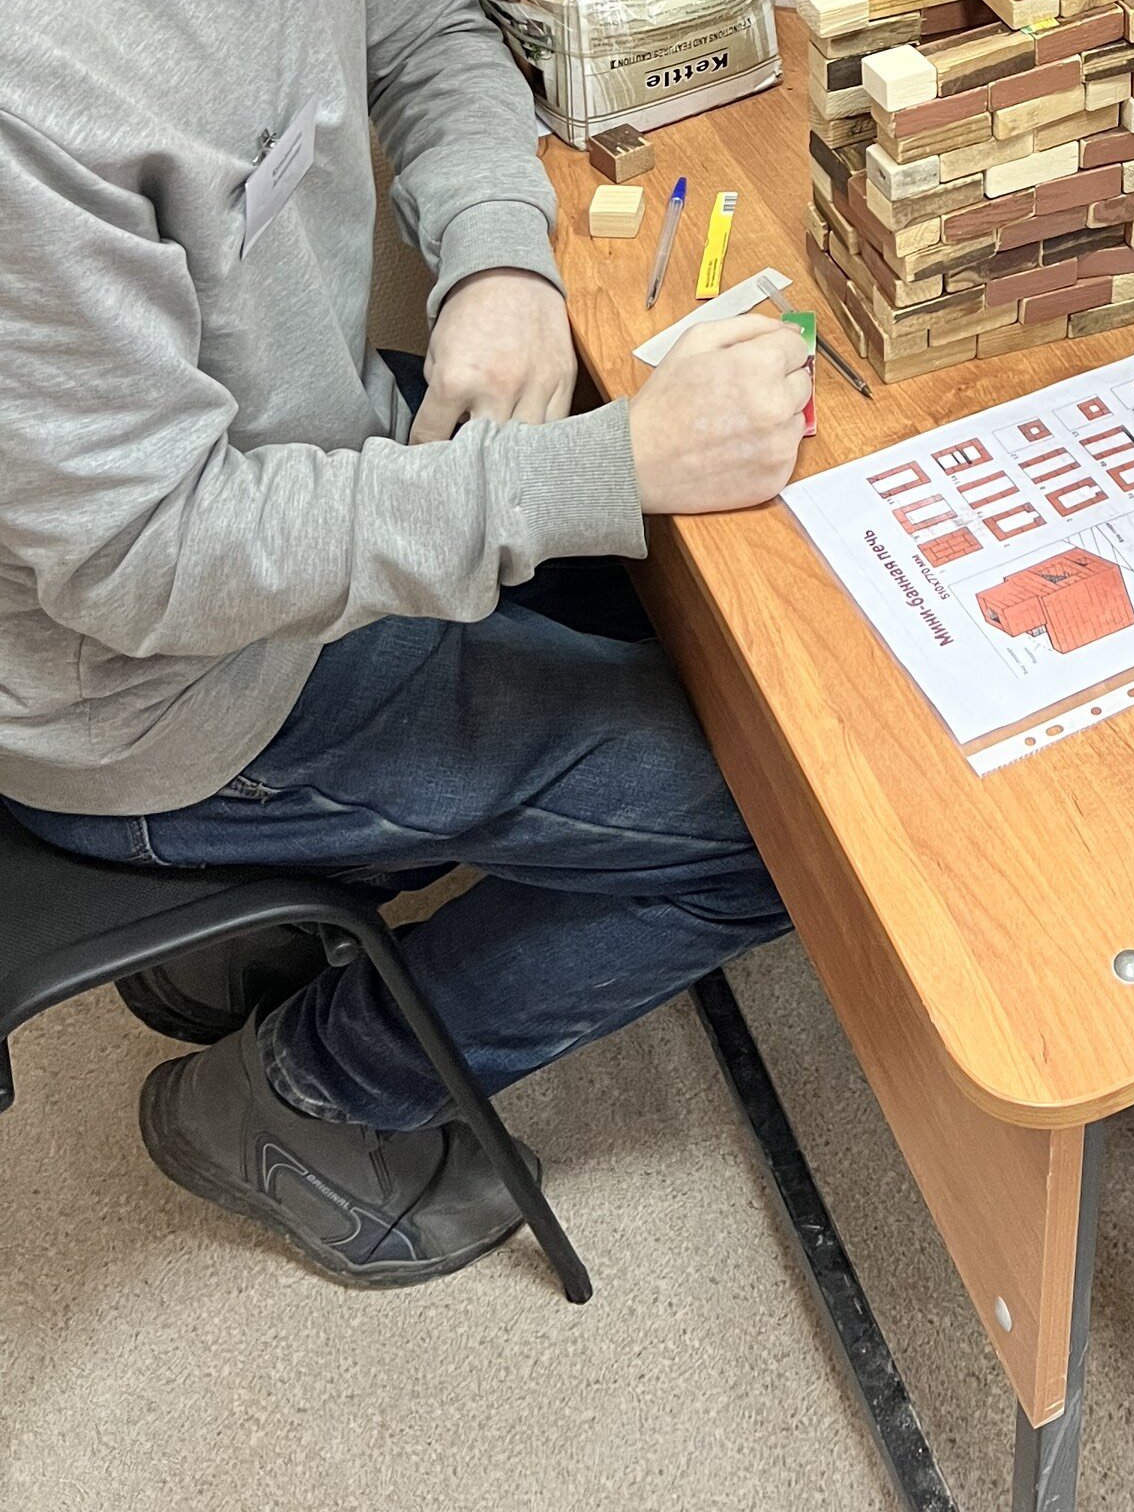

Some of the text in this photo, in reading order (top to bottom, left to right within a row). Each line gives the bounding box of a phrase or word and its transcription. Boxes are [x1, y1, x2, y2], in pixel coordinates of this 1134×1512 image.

[654, 42, 692, 59] FEATURES
[646, 52, 729, 88] Kettle
[864, 529, 954, 647] Мини-банная печь
